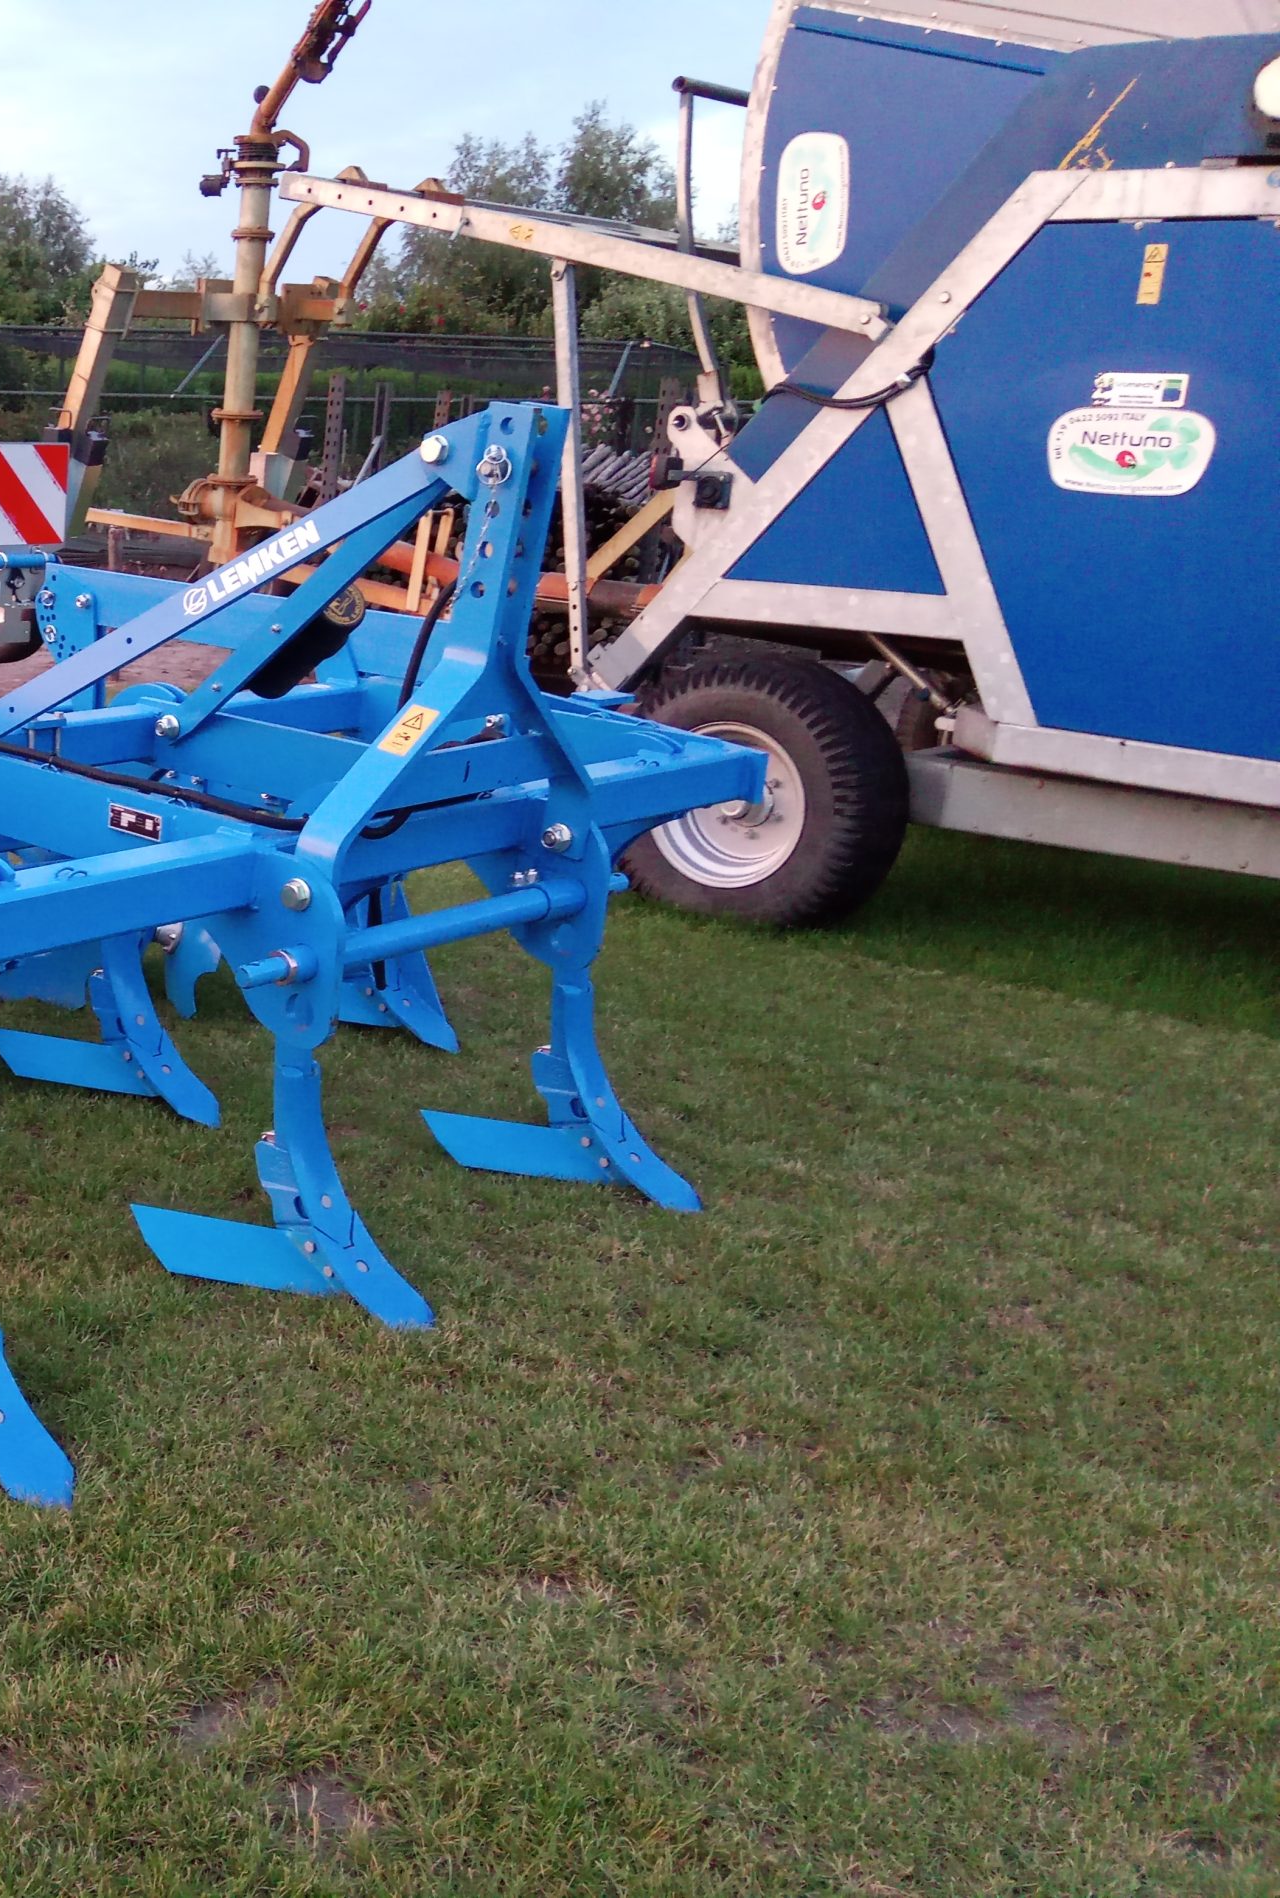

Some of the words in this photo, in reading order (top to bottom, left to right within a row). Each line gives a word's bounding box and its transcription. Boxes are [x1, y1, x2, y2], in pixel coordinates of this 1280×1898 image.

[795, 168, 809, 246] Nettuno
[1081, 430, 1173, 448] Nettuno
[1121, 412, 1146, 422] ITALY
[207, 519, 320, 601] LEMKEN
